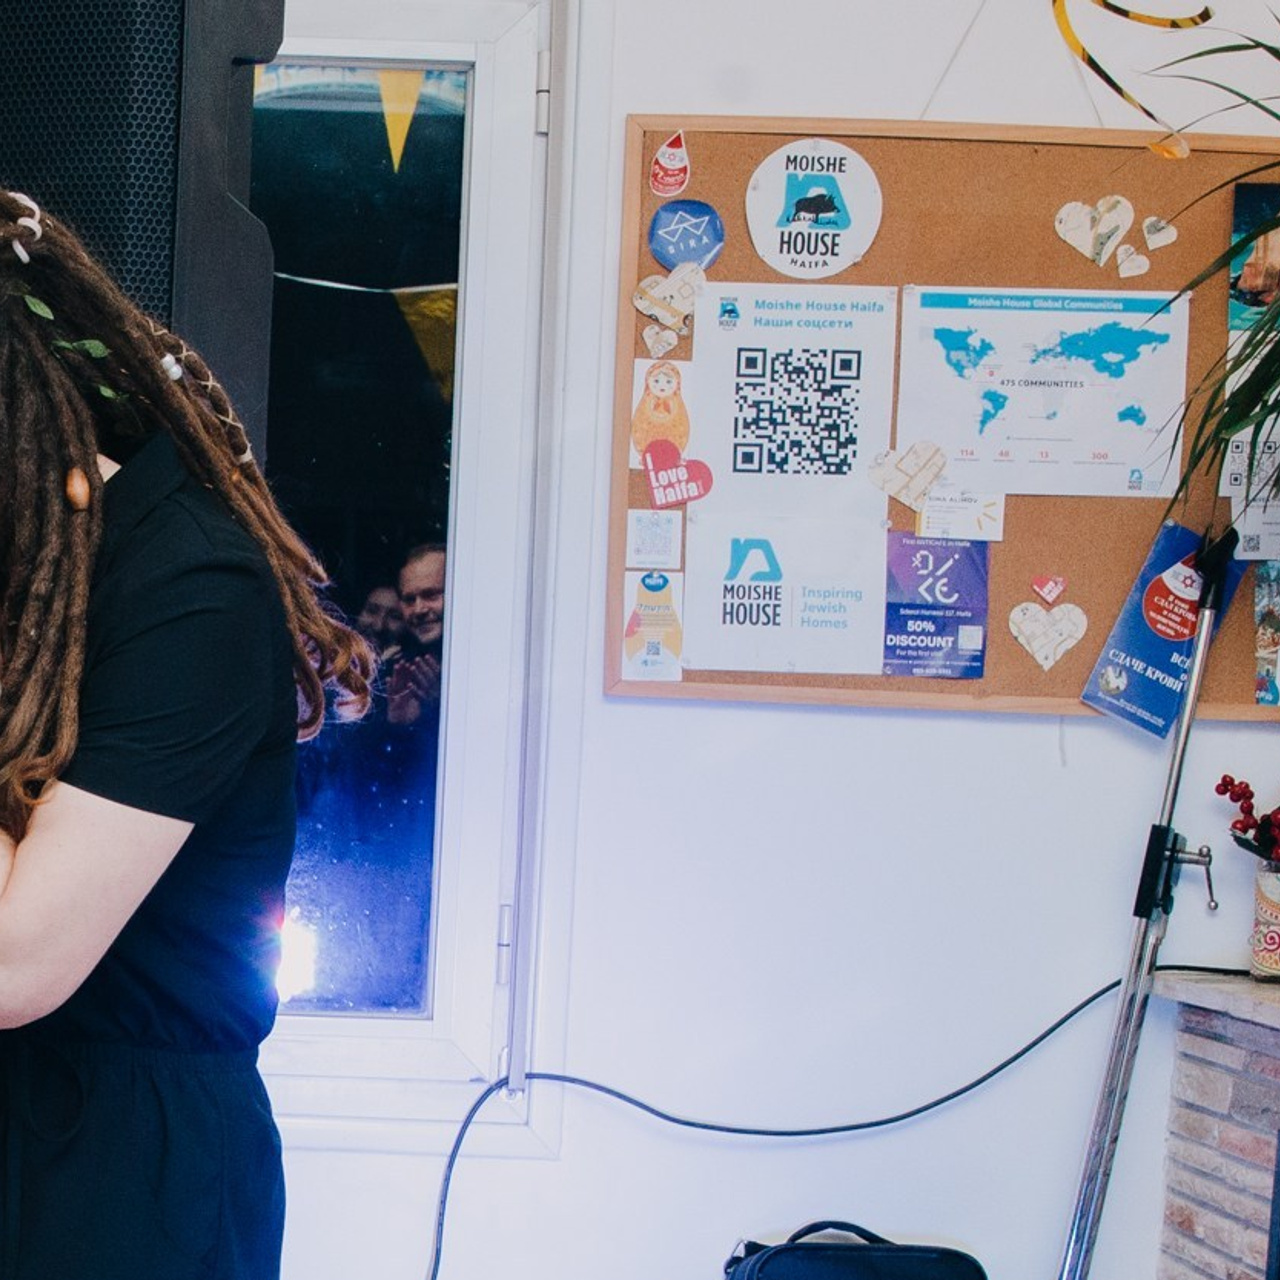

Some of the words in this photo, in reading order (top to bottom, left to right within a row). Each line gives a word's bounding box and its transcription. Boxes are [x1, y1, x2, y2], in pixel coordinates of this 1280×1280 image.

[785, 154, 847, 174] MOISHE
[779, 231, 840, 256] HOUSE
[790, 258, 829, 269] HAIFA
[754, 300, 801, 310] Moishe
[806, 301, 846, 311] House
[850, 301, 884, 313] Haifa
[754, 317, 793, 328] Наши
[797, 319, 853, 330] соцсети
[1018, 379, 1084, 388] COMMUNITIES
[645, 453, 653, 470] I
[650, 466, 689, 488] Love
[654, 481, 699, 505] Haifa
[723, 584, 782, 601] MOISHE
[801, 586, 863, 601] Inspiring
[722, 602, 782, 626] HOUSE
[801, 602, 847, 613] Jewish
[801, 617, 848, 629] Homes
[907, 620, 935, 632] 50%
[886, 635, 955, 648] DISCOUNT
[1109, 648, 1147, 674] СДАЧЕ
[1145, 665, 1183, 693] КРОВИ
